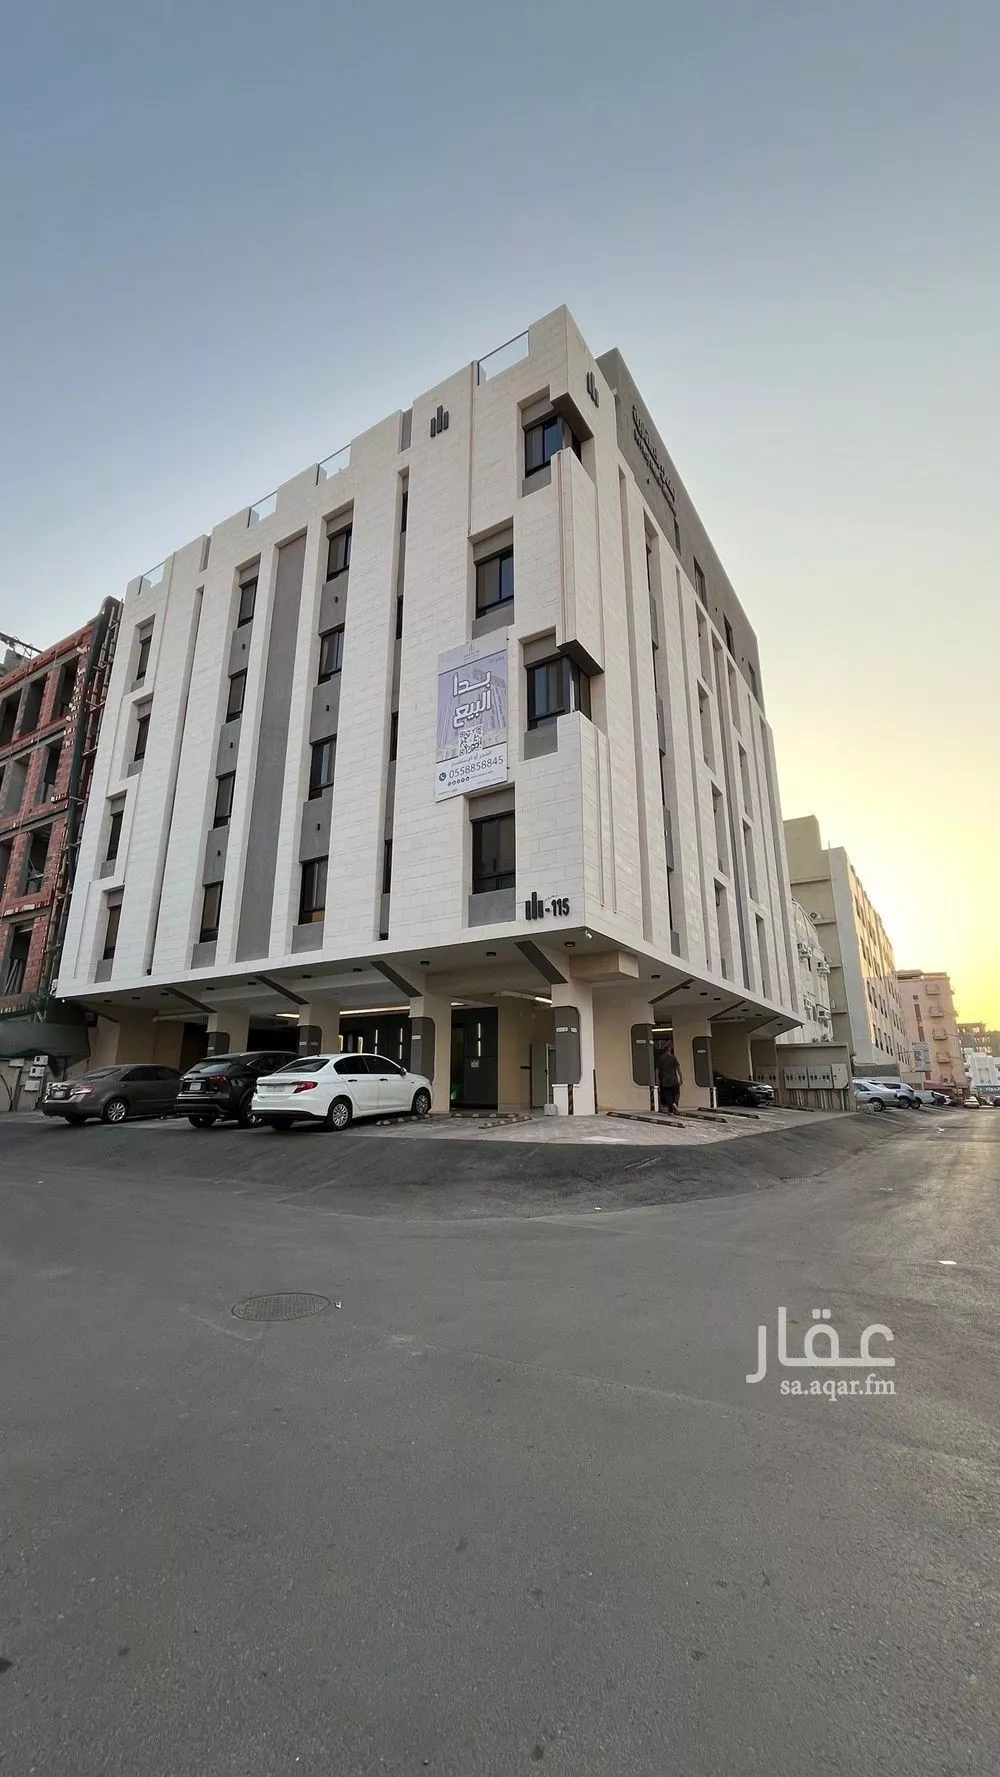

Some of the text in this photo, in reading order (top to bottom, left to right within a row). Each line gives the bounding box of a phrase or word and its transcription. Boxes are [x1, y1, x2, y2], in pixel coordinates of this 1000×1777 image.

[453, 671, 491, 697] بدأ
[453, 689, 491, 728] البيع
[449, 755, 504, 779] 0558858845
